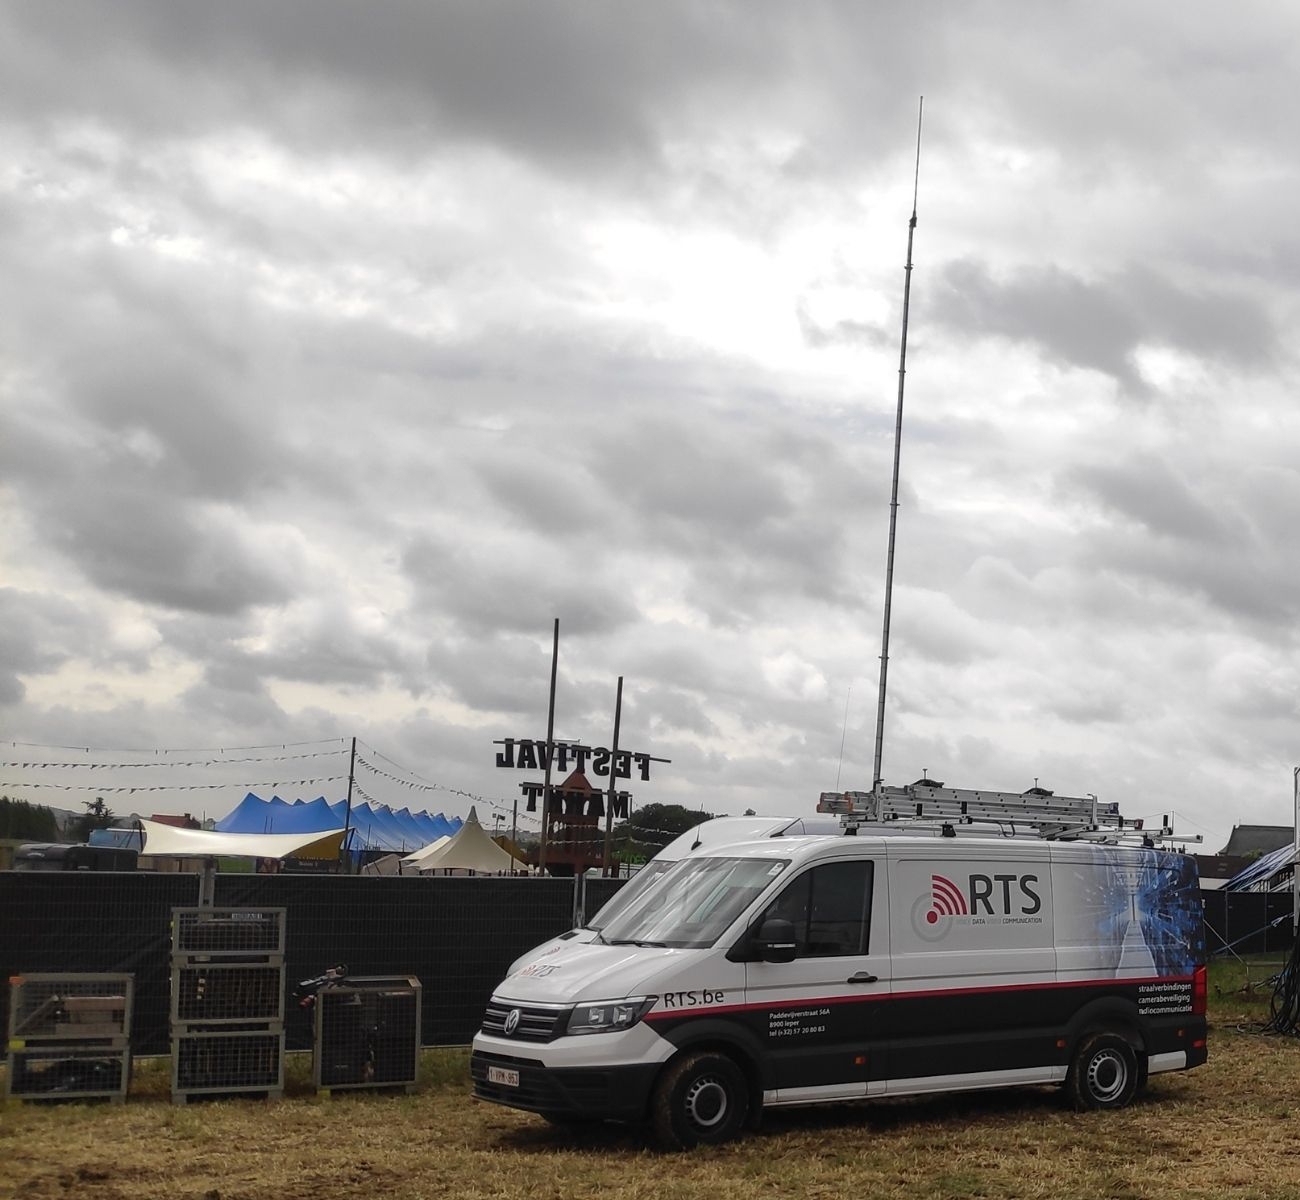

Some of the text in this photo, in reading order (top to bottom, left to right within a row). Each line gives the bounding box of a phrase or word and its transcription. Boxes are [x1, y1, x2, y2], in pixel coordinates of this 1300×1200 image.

[968, 874, 1041, 915] RTS
[1138, 982, 1192, 992] straalverbindingen
[664, 989, 724, 1008] RTS.be
[1138, 993, 1191, 1004] camerabeveiliging
[769, 1010, 818, 1019] Paddevijverstraat
